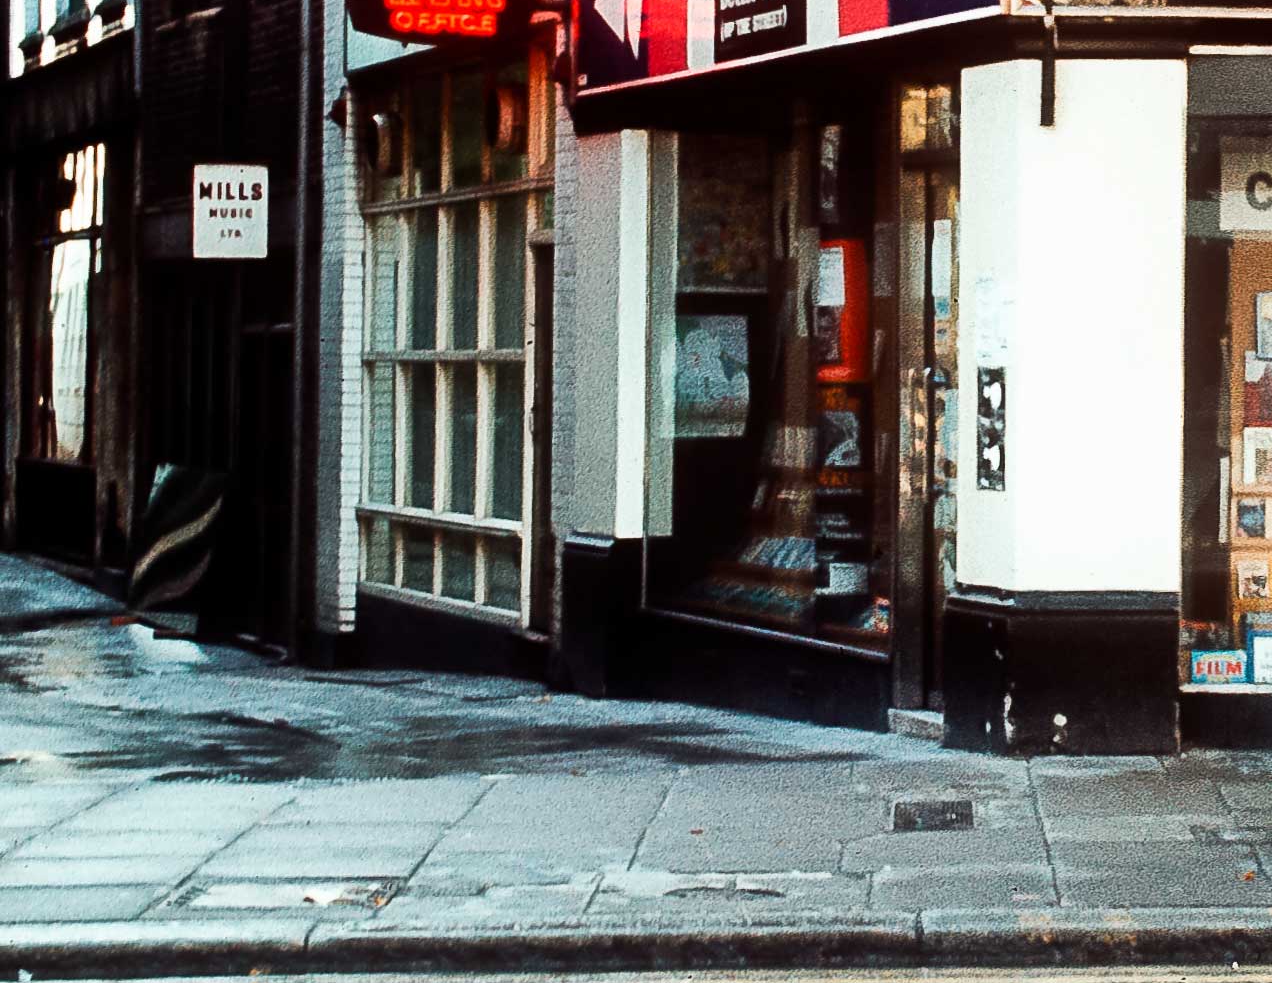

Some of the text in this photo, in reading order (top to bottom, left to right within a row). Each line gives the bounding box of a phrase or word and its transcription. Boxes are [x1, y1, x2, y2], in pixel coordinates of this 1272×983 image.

[392, 12, 496, 34] OFFICE
[199, 181, 263, 201] MILLS
[209, 208, 253, 219] MUSIC
[1196, 661, 1243, 676] FILM
